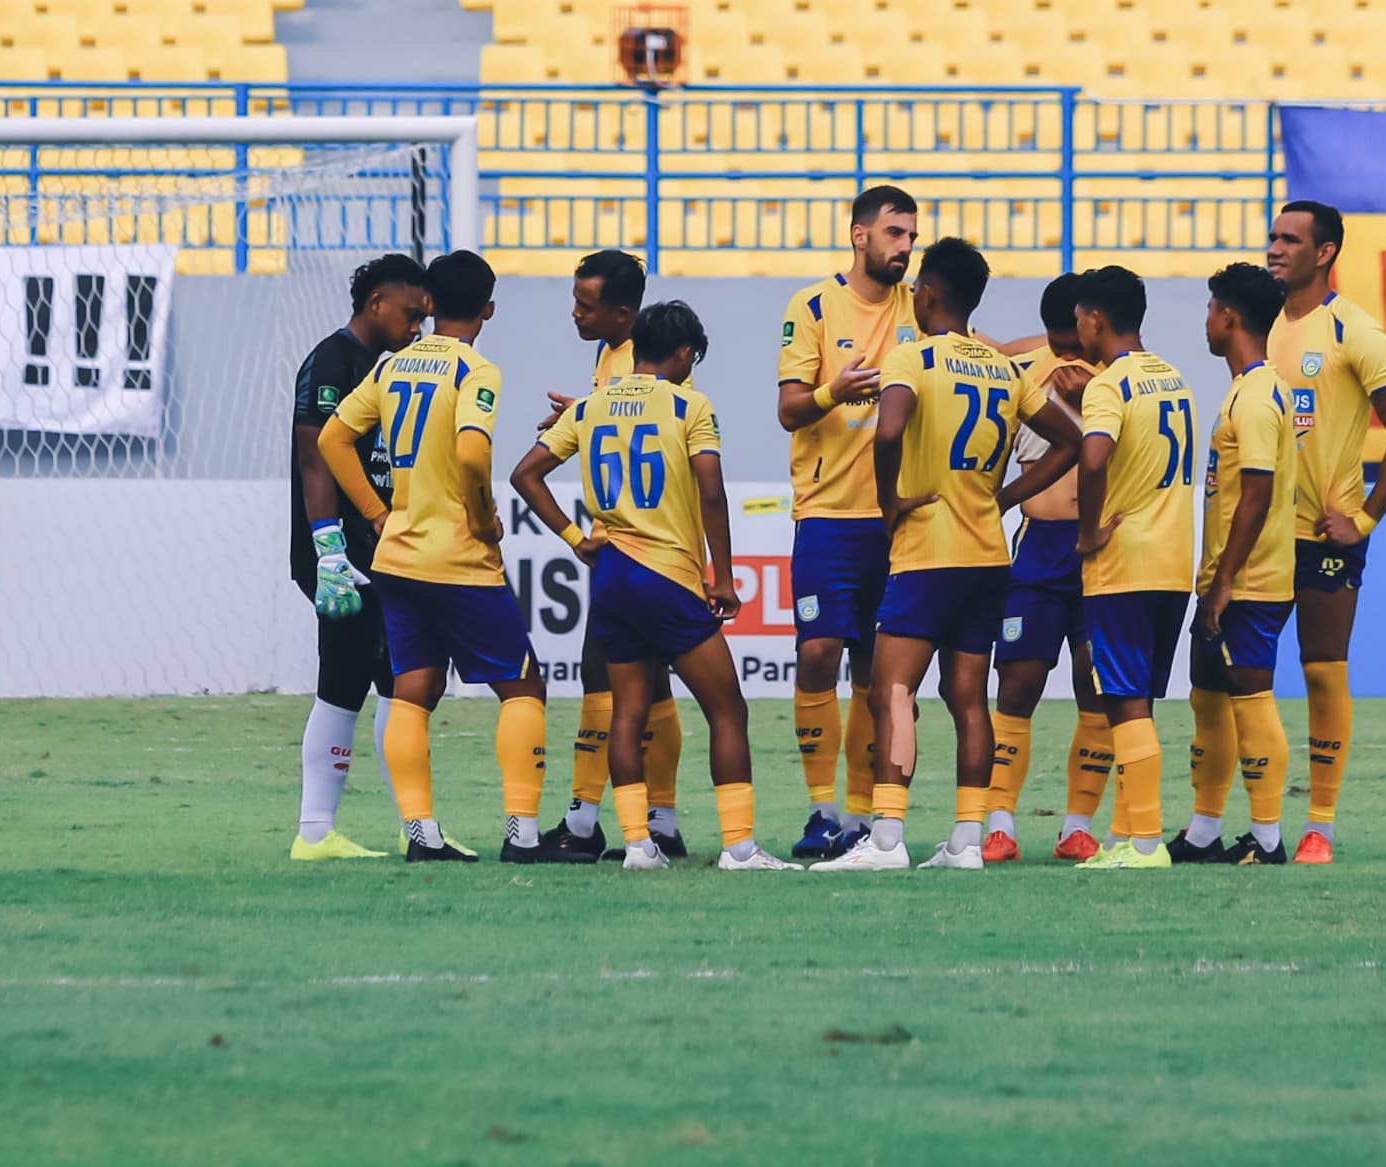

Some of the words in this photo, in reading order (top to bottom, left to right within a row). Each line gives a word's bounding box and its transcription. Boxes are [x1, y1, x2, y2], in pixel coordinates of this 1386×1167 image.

[387, 381, 438, 468] 27
[609, 401, 646, 417] DICKY
[949, 382, 1011, 472] 25
[1156, 399, 1193, 489] 51
[589, 424, 666, 511] 66
